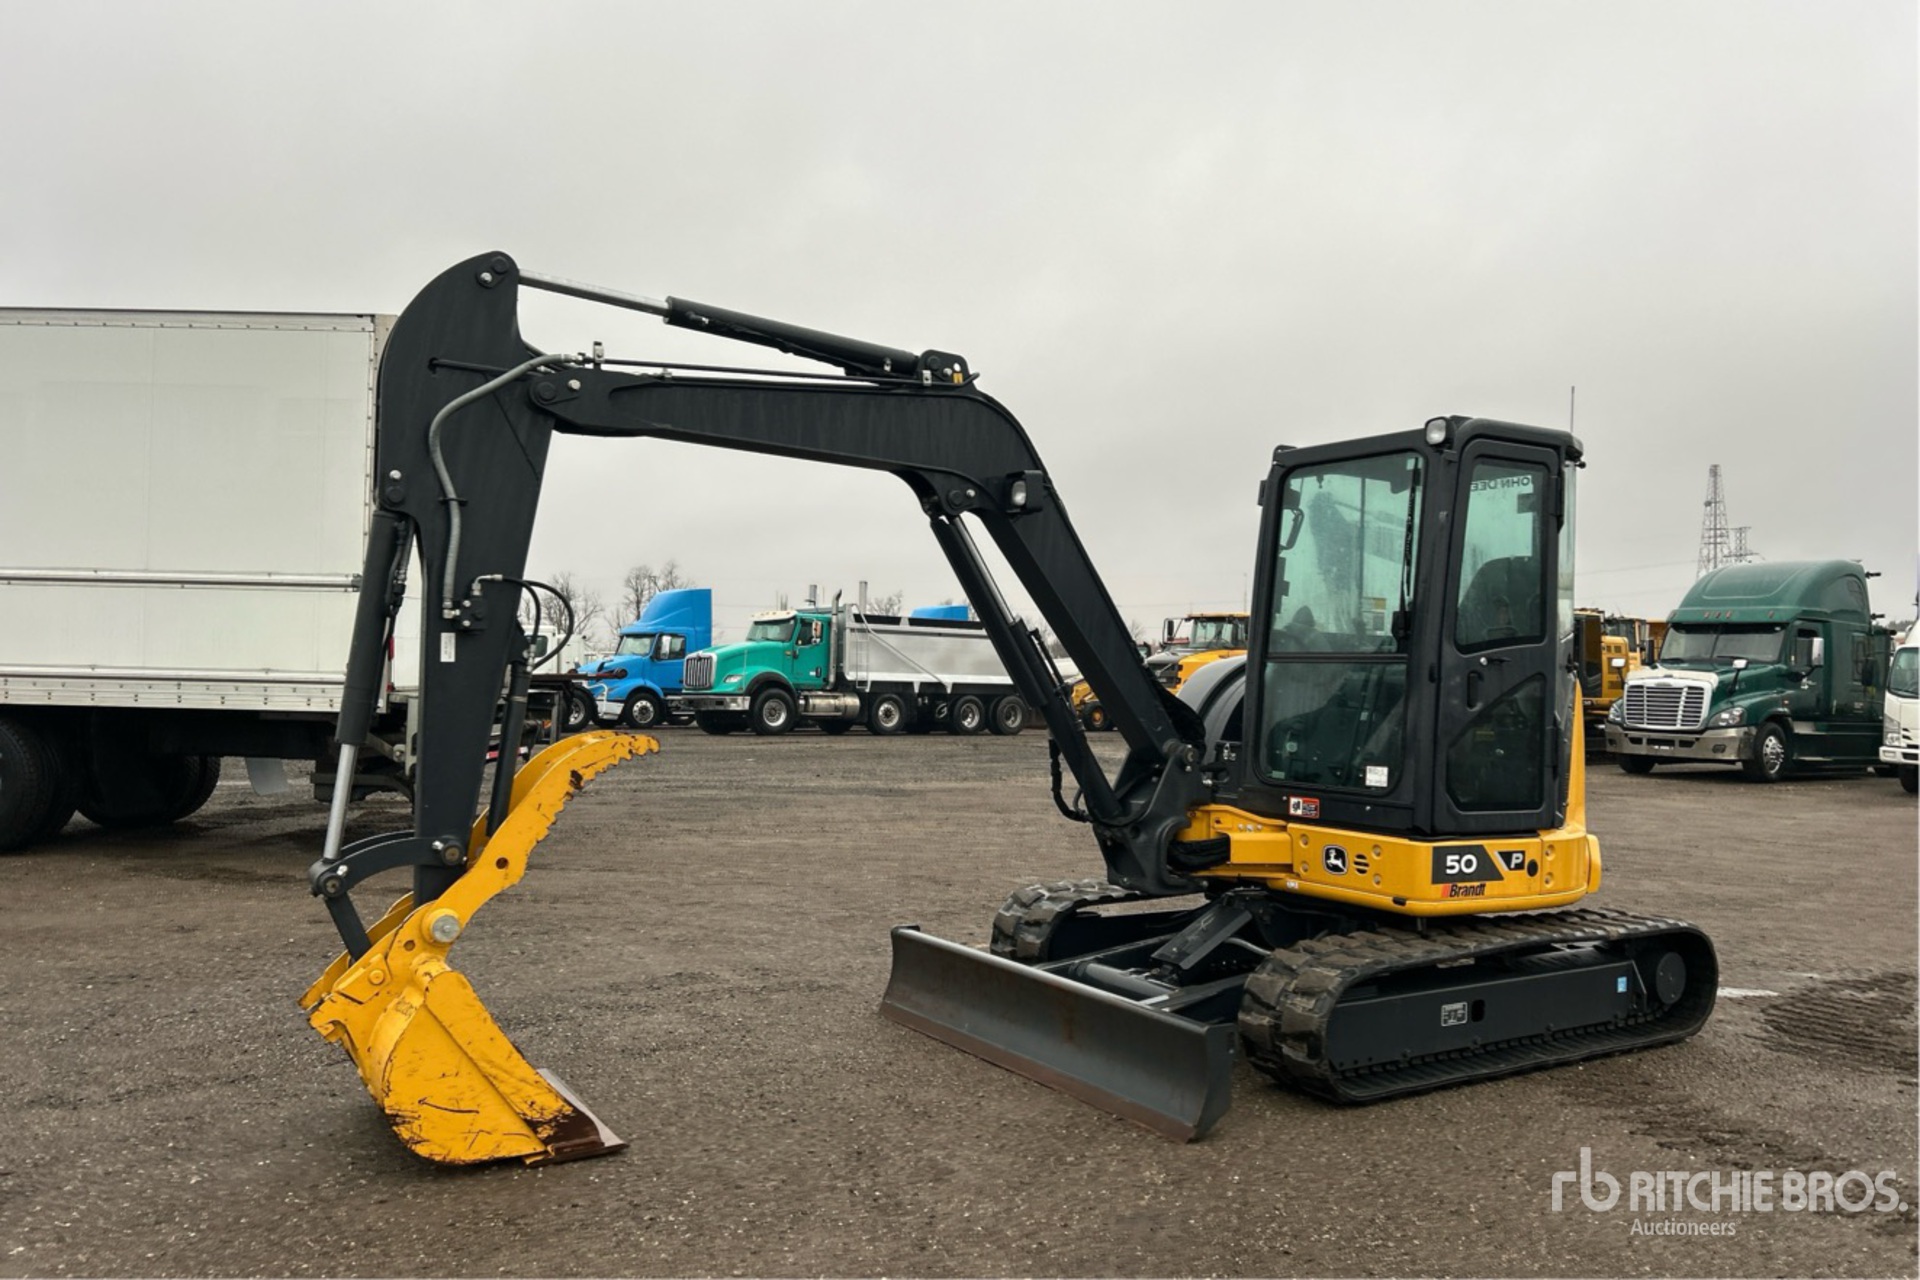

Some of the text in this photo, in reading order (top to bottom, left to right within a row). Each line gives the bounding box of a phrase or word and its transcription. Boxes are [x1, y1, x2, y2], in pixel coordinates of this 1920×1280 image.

[1445, 852, 1524, 875] 50 P
[1449, 883, 1487, 898] Brandt
